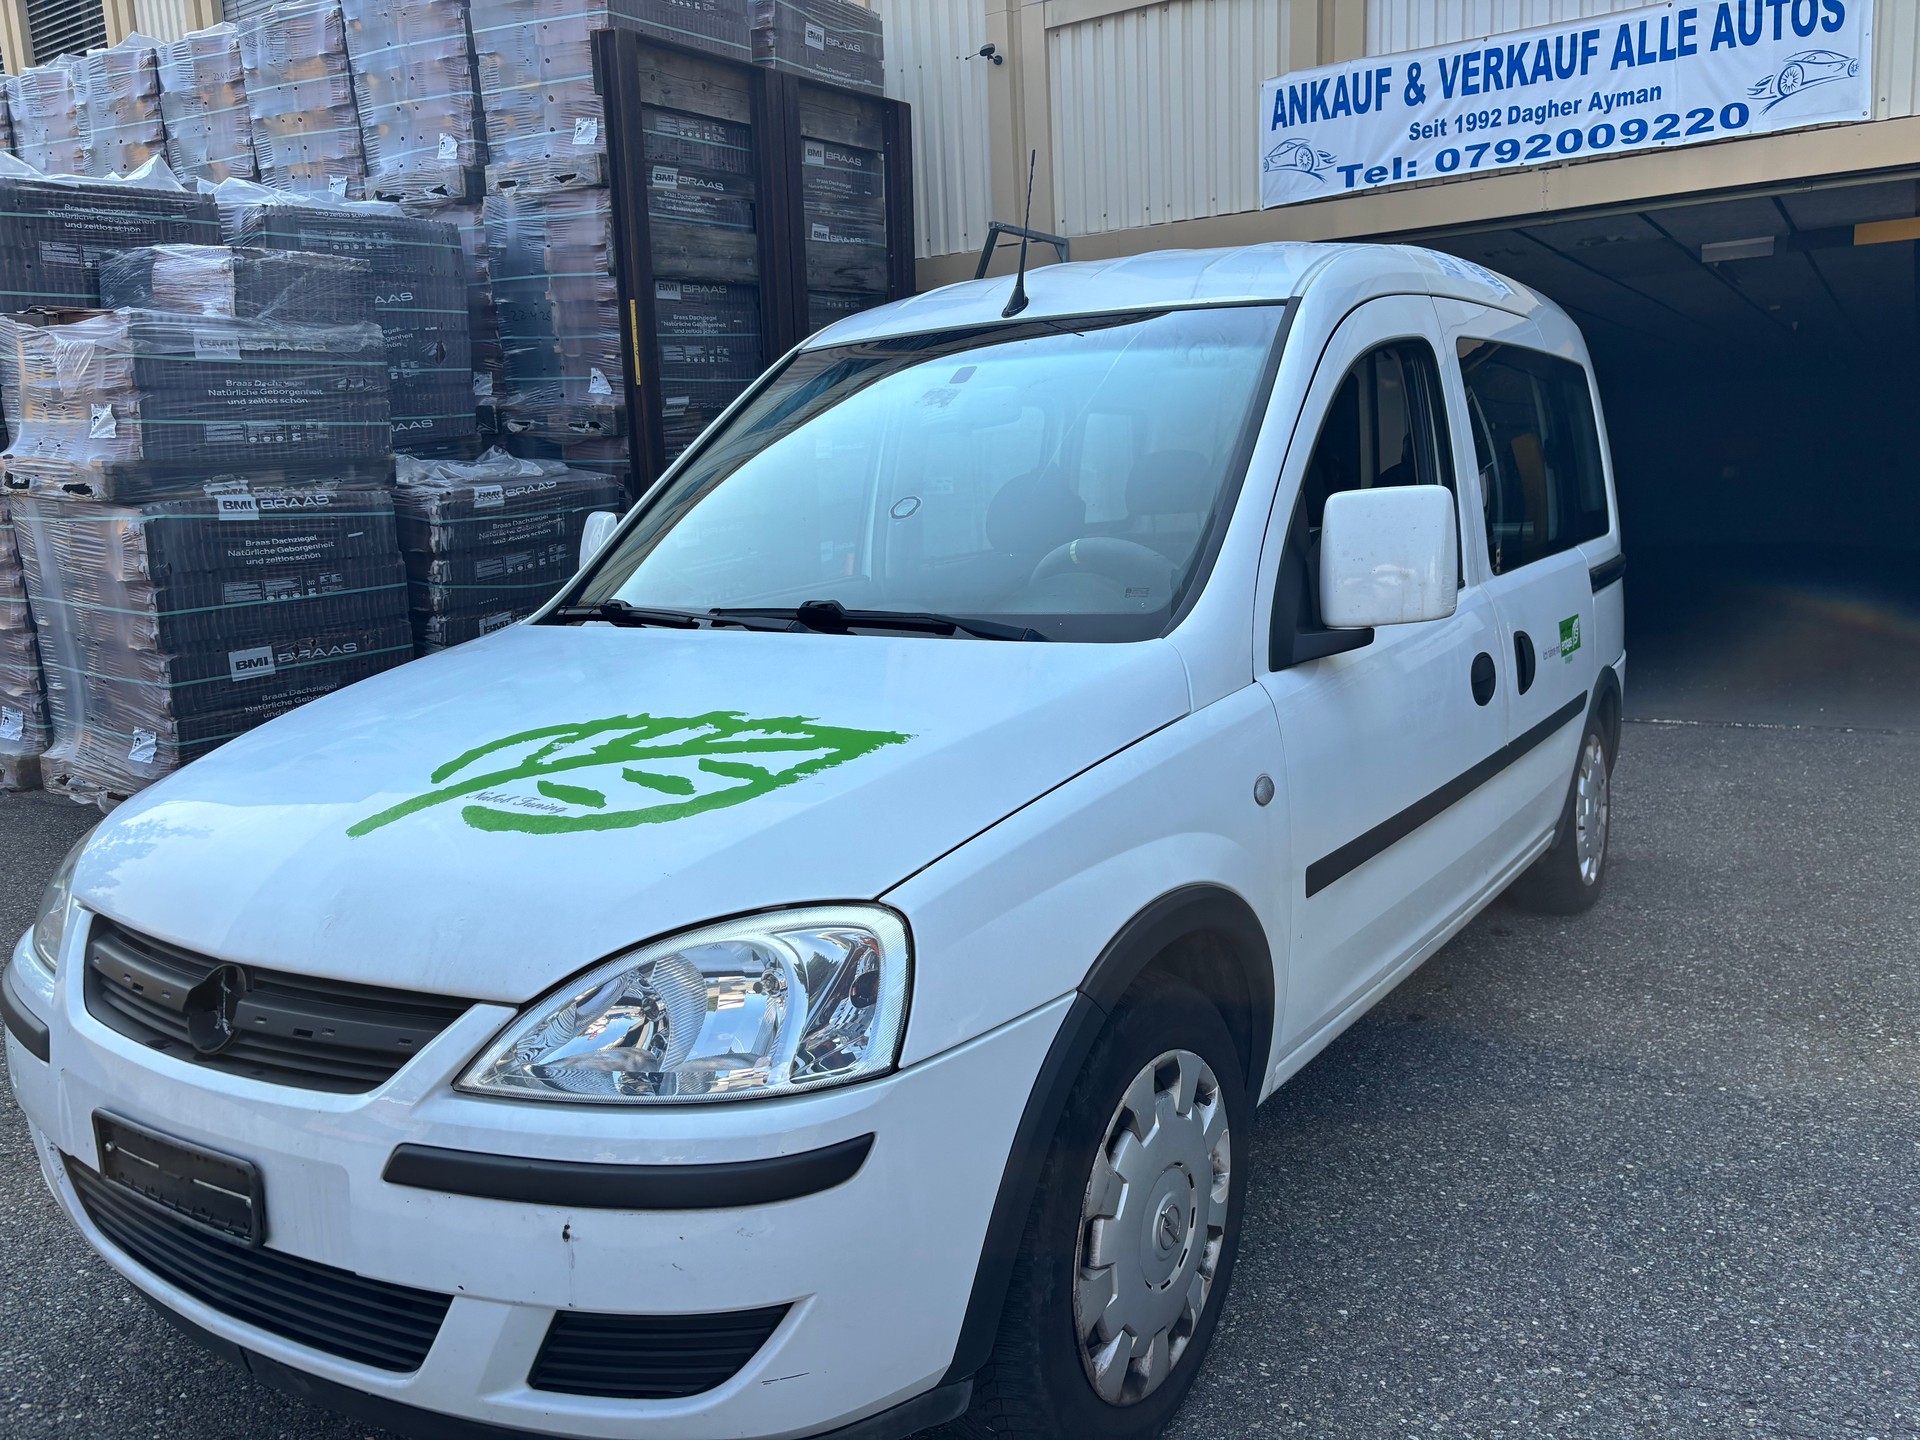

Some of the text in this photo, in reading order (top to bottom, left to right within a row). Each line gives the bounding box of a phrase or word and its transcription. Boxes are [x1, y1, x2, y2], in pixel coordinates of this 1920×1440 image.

[826, 37, 861, 53] BRAAS
[1271, 0, 1846, 131] ANKAUF & VERKAUF ALLE AUTOS
[1408, 85, 1662, 141] Seit 1992 Dagher Ayman
[1336, 102, 1749, 188] Tel: 0792009220
[807, 148, 862, 167] BMI BRAAS
[655, 173, 724, 191] BMI BRAAS
[64, 221, 82, 230] und
[658, 283, 727, 294] BMI BRAAS
[375, 291, 414, 304] AAS
[225, 379, 252, 387] Braas
[208, 387, 324, 397] Natürliche Geborgenheit
[227, 396, 309, 405] und zeitlos schön
[390, 419, 434, 432] RAAS
[505, 481, 557, 497] BRAAS
[223, 494, 330, 510] BMI BRAAS
[492, 514, 549, 530] Braas Dachziegel
[246, 534, 318, 547] Braas Dachziegel
[228, 541, 335, 557] Natürliche Geborgenheit
[246, 551, 321, 565] und zeitlos schön
[235, 642, 358, 671] BMI BRAAS
[261, 692, 288, 701] Braas
[288, 683, 338, 696] Dachziegel
[244, 698, 293, 713] Natürliche
[263, 708, 286, 719] und
